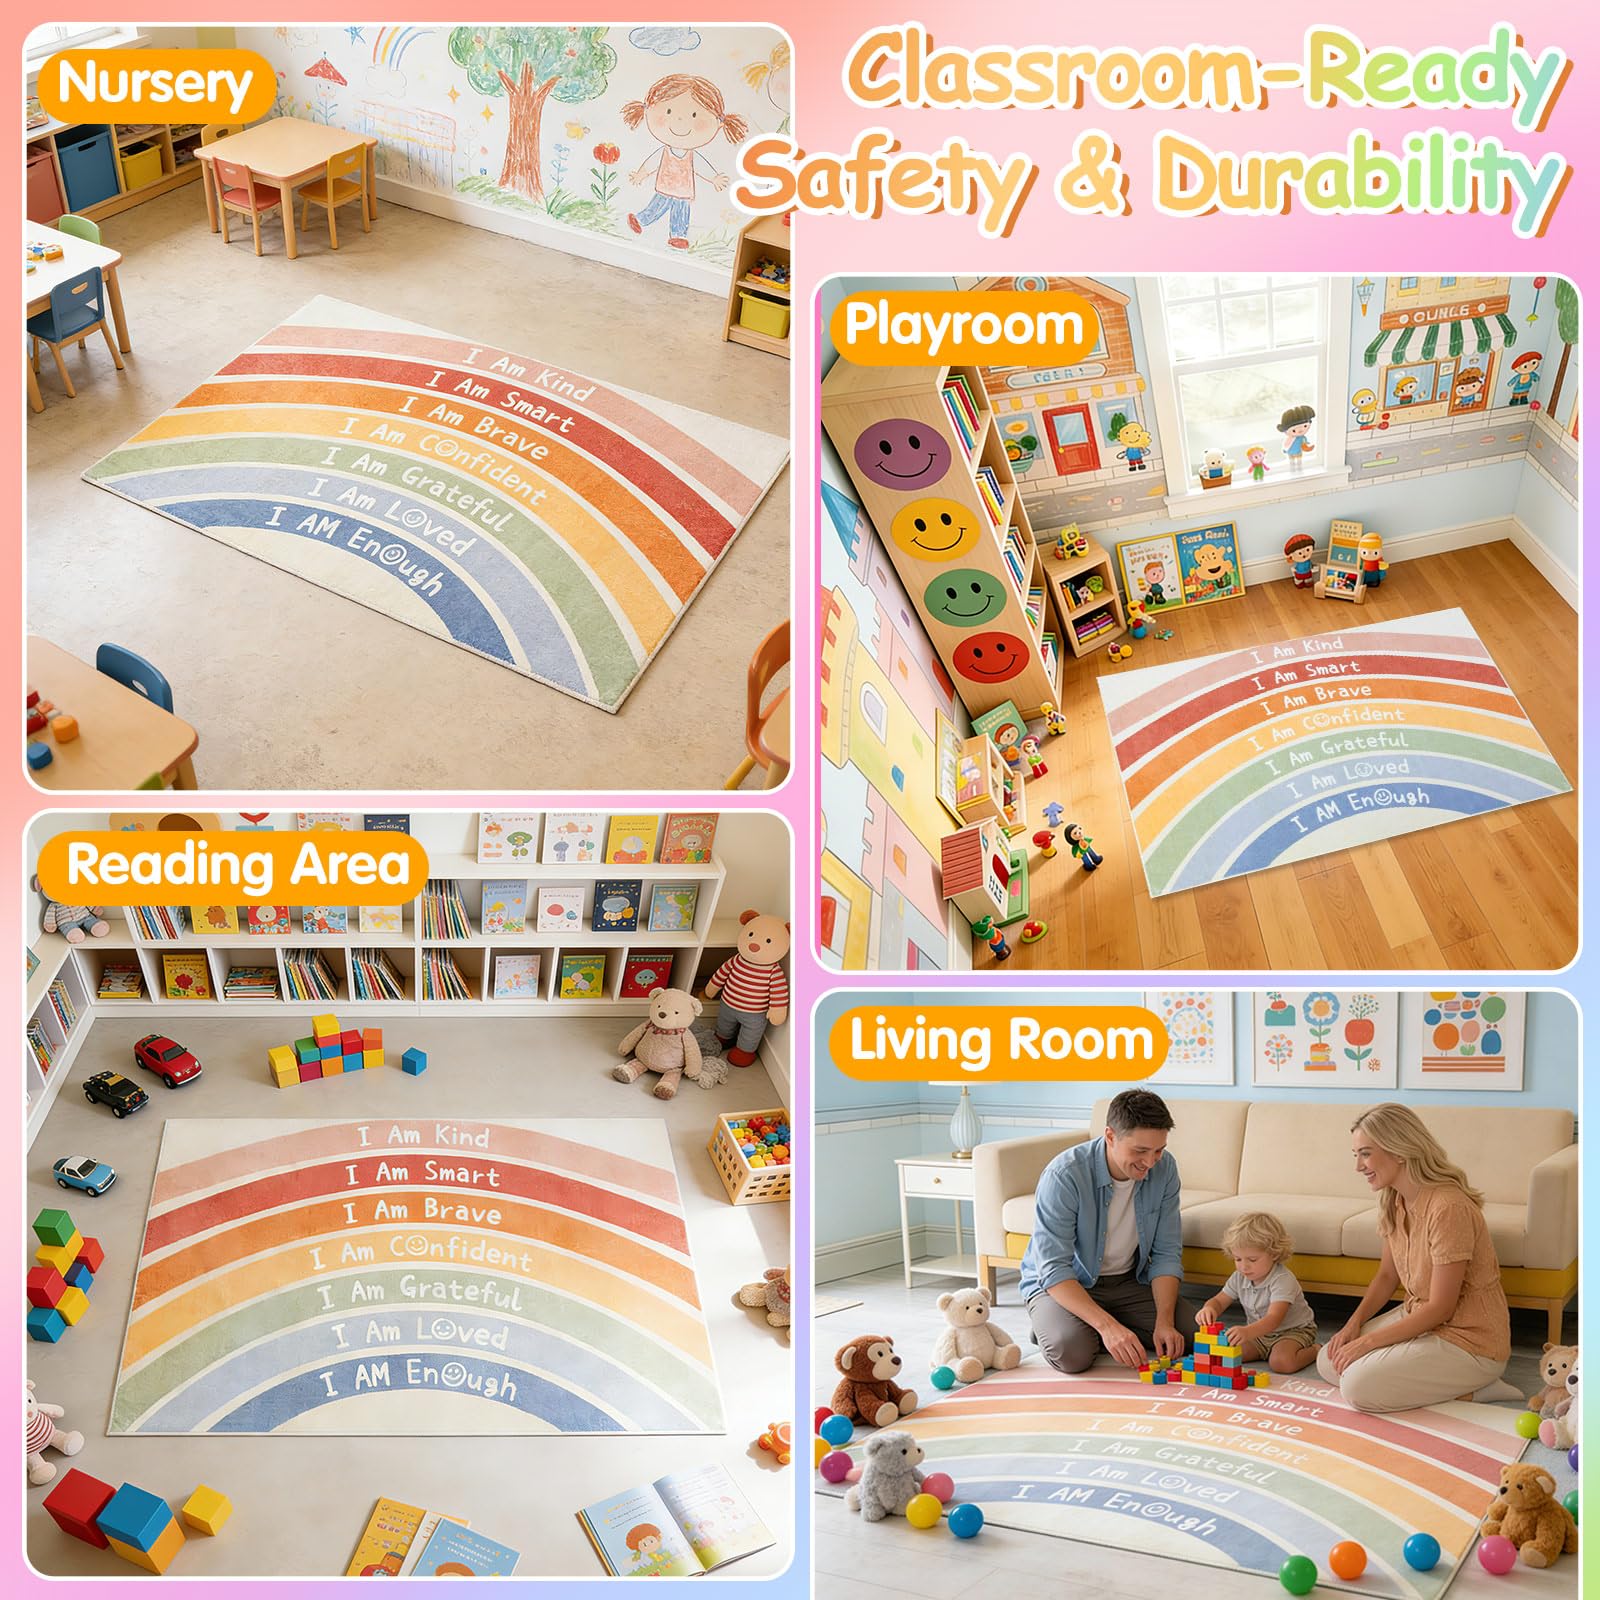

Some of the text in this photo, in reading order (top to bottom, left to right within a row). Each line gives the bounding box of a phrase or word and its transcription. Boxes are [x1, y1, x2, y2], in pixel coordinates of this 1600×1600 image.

[462, 347, 597, 401] I Am Kind
[425, 370, 575, 433] I Am Smart
[339, 417, 360, 434] I
[369, 423, 404, 445] Am
[398, 395, 548, 460] I Am Brave
[308, 478, 328, 497] I
[340, 486, 377, 510] Am
[321, 446, 514, 532] I Am Grateful
[265, 506, 287, 526] I
[299, 513, 342, 539] AM
[1250, 637, 1344, 664] I Am Kind
[1251, 661, 1361, 691] I Am Smart
[1260, 685, 1372, 716] I Am Brave
[1248, 736, 1263, 751] I
[1271, 728, 1295, 742] Am
[1265, 731, 1409, 776] I Am Grateful
[1287, 782, 1303, 799] I
[1311, 774, 1337, 790] Am
[1290, 815, 1309, 833] I
[1316, 800, 1342, 823] AM
[358, 1123, 490, 1149] I Am Kind
[345, 1160, 500, 1187] I Am Smart
[343, 1197, 502, 1225] I Am Brave
[309, 1247, 326, 1270] I
[341, 1242, 374, 1263] Am
[317, 1274, 523, 1311] I Am Grateful
[331, 1323, 349, 1349] I
[366, 1320, 401, 1344] Am
[319, 1371, 338, 1397] I
[355, 1361, 390, 1390] AM
[1279, 1378, 1336, 1398] Kind
[1174, 1387, 1325, 1418] I Am Smart
[1086, 1419, 1105, 1431] I
[1120, 1421, 1153, 1434] Am
[1146, 1402, 1304, 1437] I Am Brave
[1055, 1461, 1077, 1475] I
[1089, 1463, 1128, 1480] Am
[1067, 1439, 1278, 1487] I Am Grateful
[1012, 1484, 1035, 1499] I
[1048, 1486, 1095, 1503] AM
